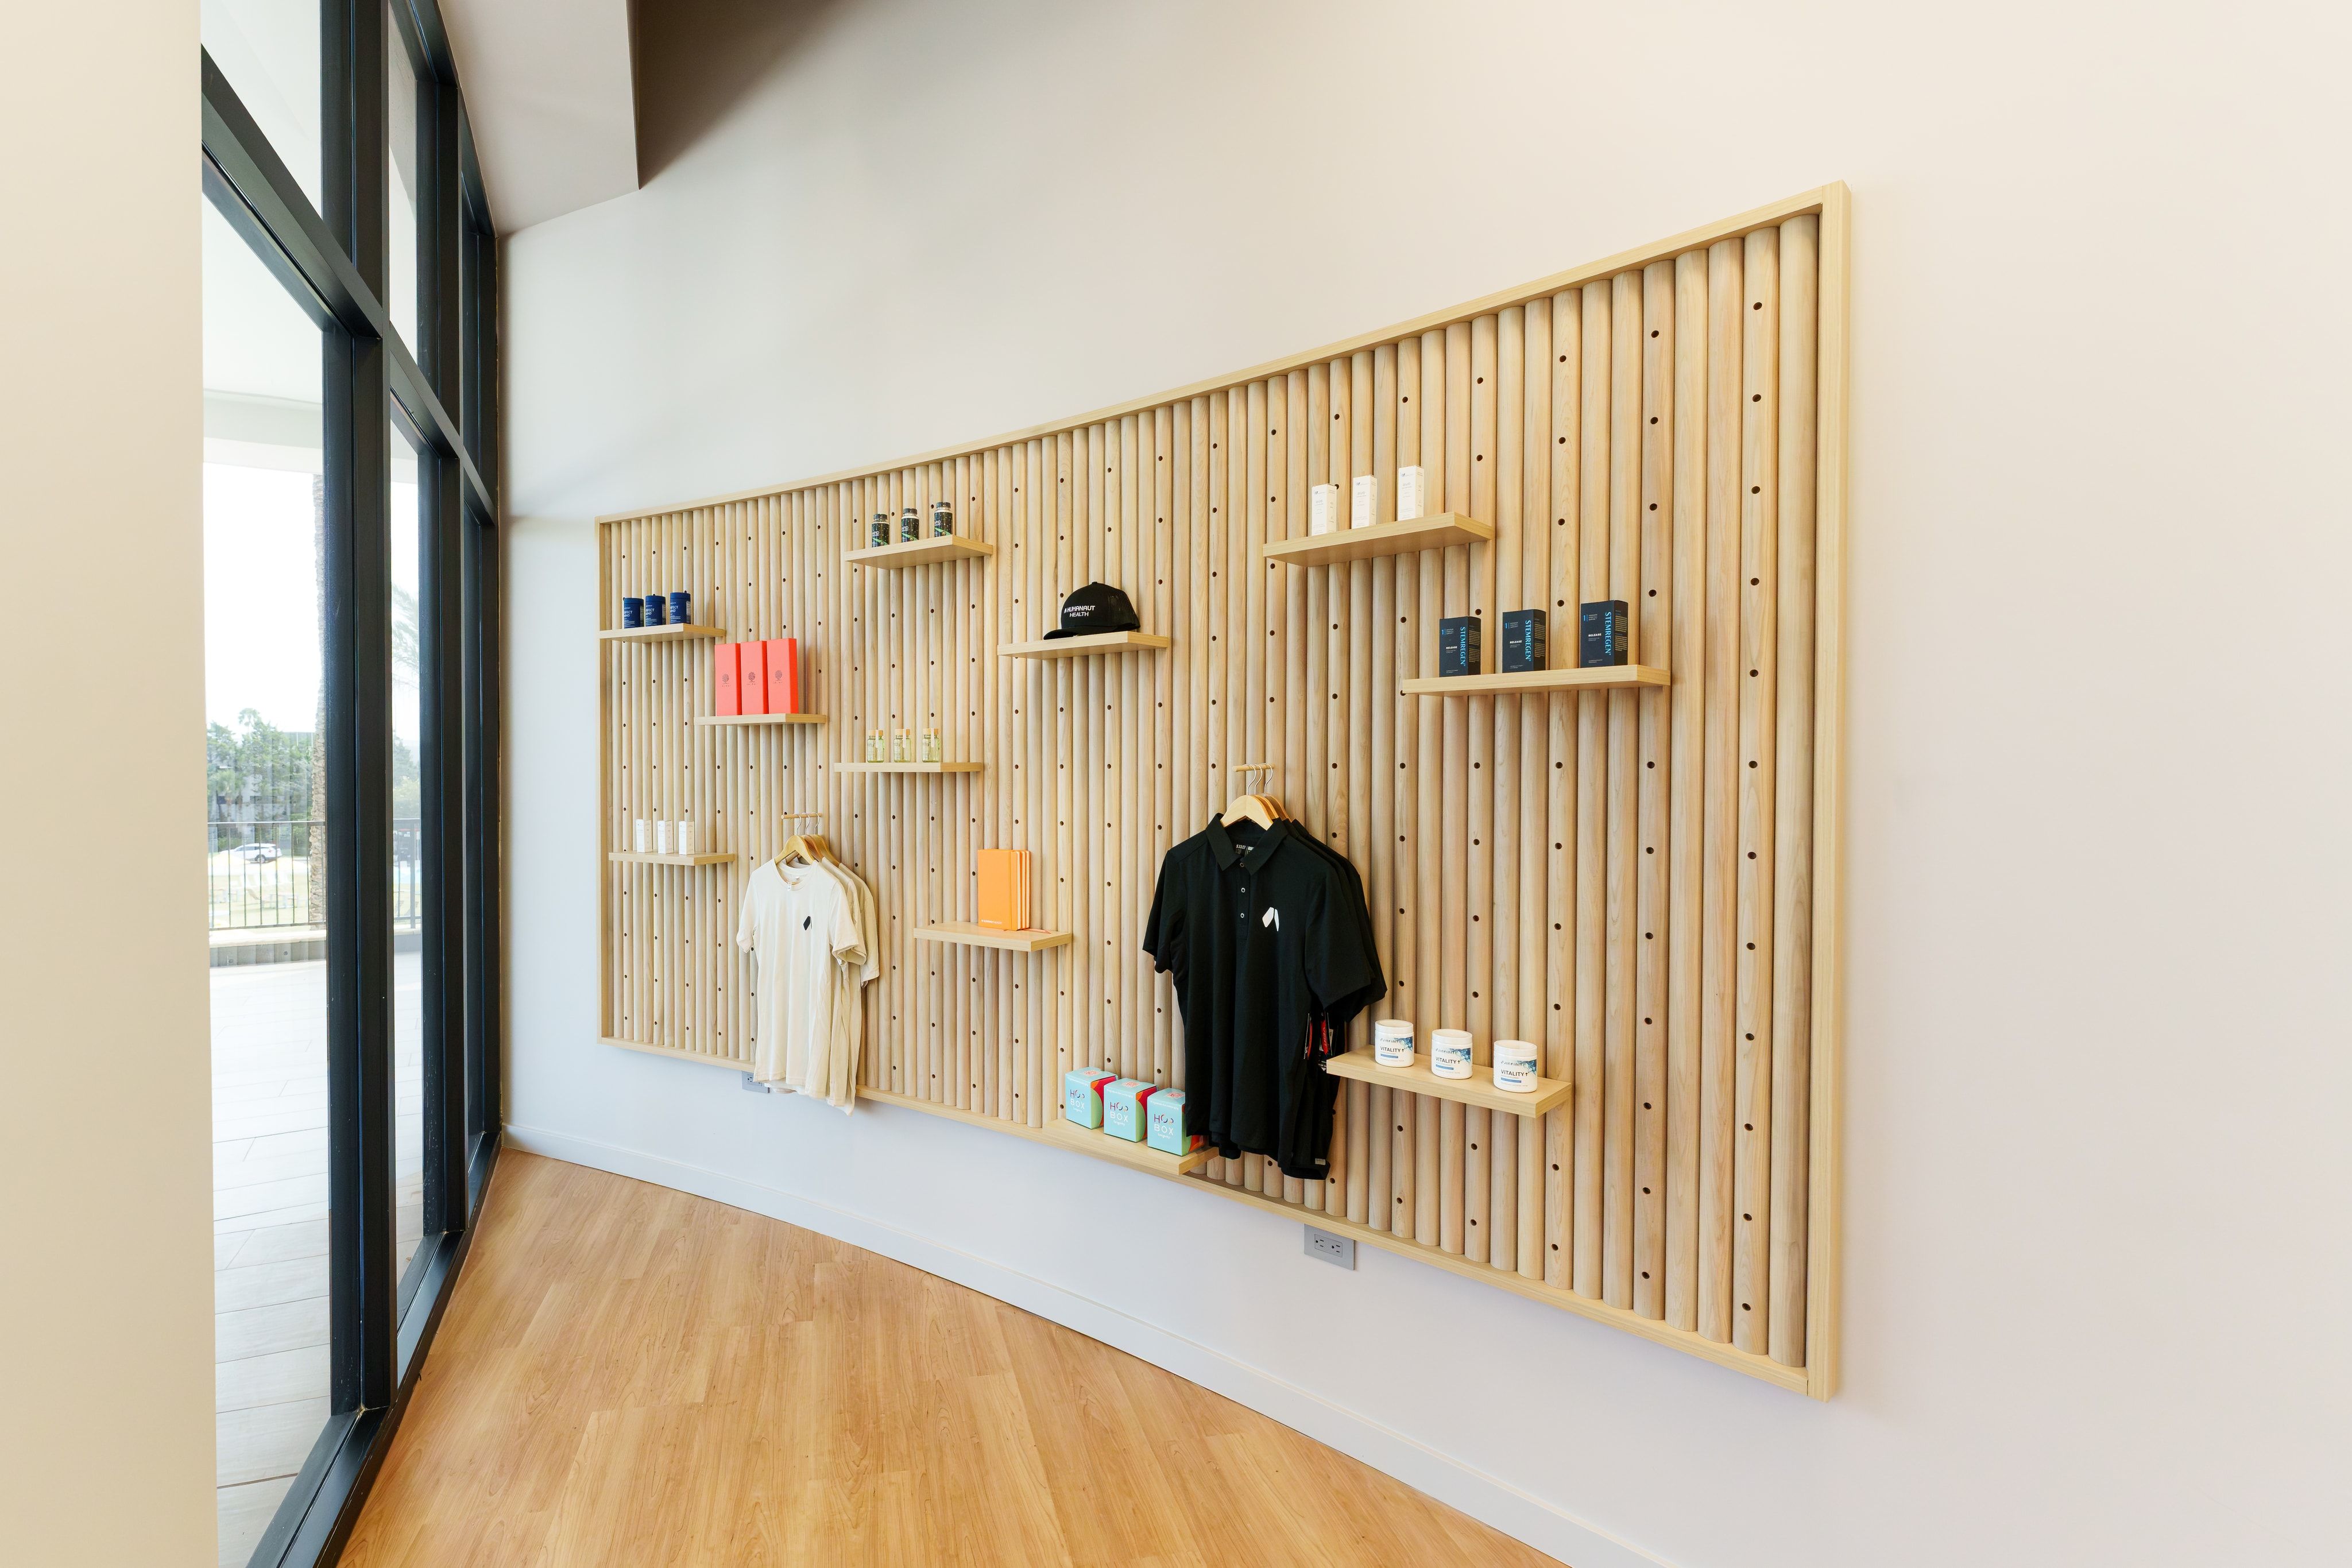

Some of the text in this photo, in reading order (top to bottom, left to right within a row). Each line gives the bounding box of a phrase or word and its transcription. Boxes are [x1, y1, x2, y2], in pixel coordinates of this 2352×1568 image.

[1500, 1068, 1525, 1077] VITALITY
[1070, 1098, 1085, 1110] BOX
[1110, 1111, 1128, 1122] BOX
[1154, 1123, 1174, 1136] BOX
